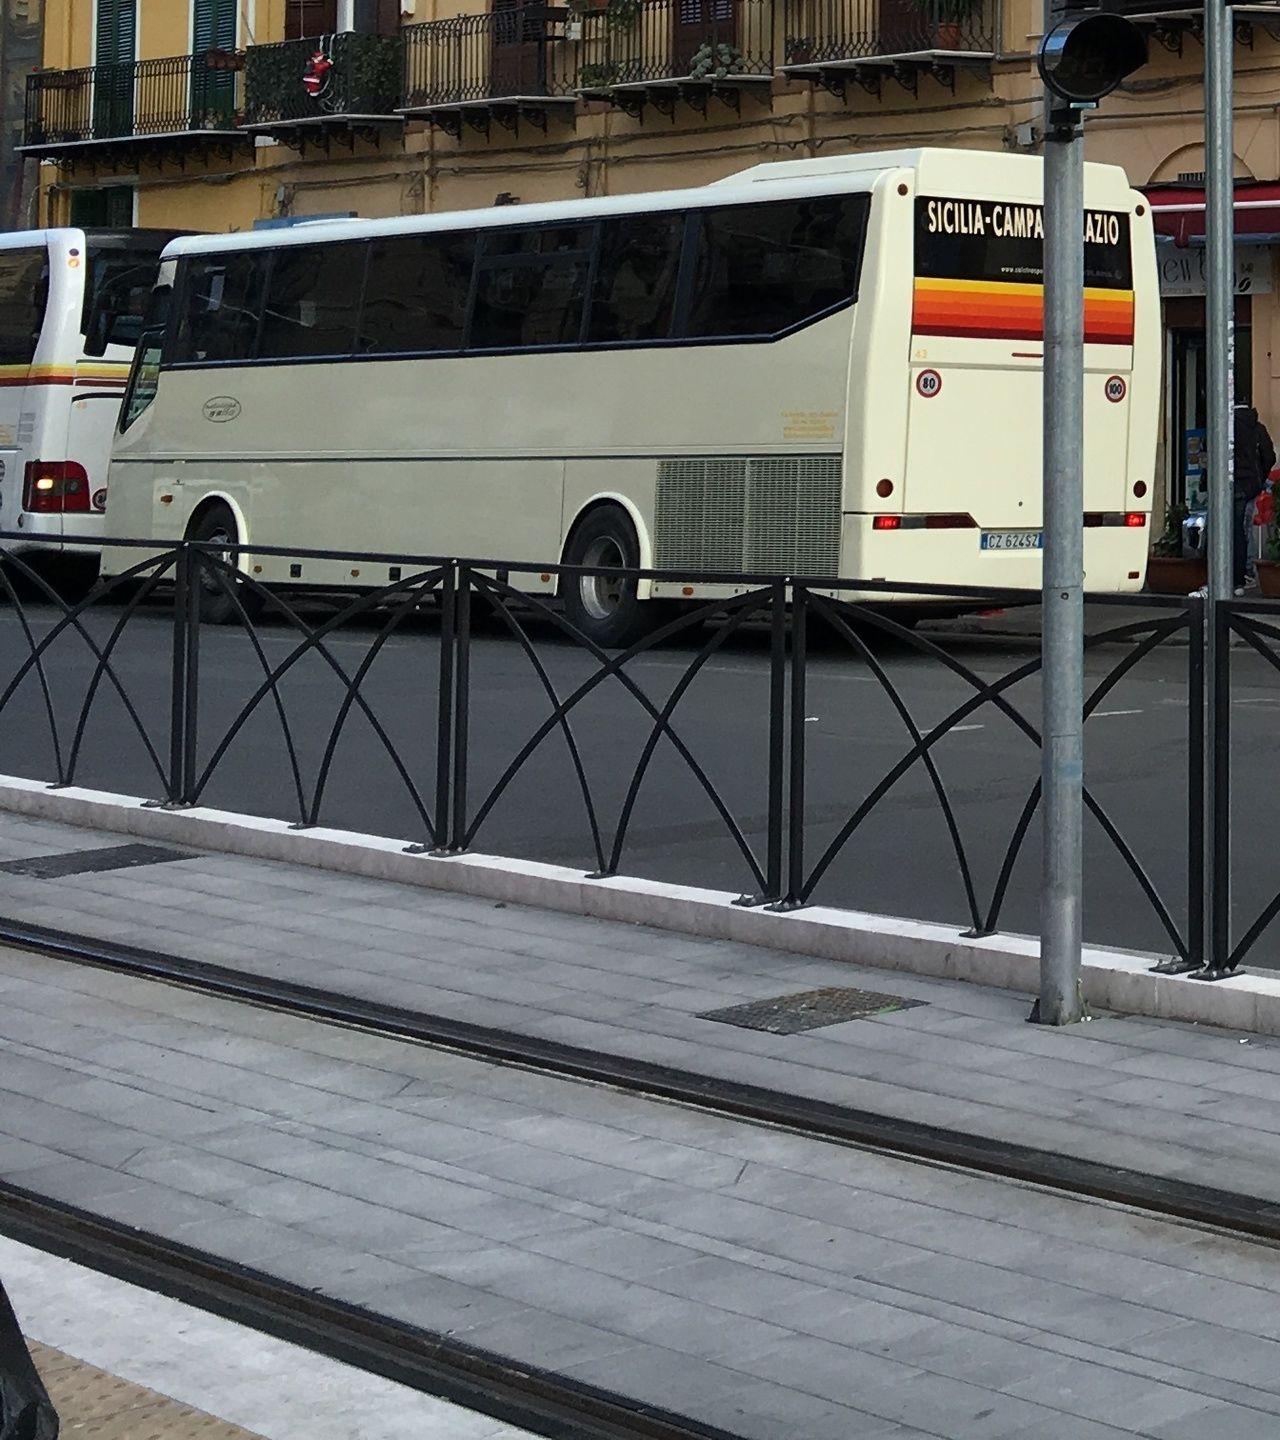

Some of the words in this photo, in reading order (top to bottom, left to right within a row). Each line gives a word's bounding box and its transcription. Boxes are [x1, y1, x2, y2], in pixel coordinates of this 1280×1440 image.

[922, 377, 936, 390] 80
[1109, 383, 1123, 395] 100
[988, 534, 1003, 549] CZ
[1005, 533, 1037, 548] 624SZ
